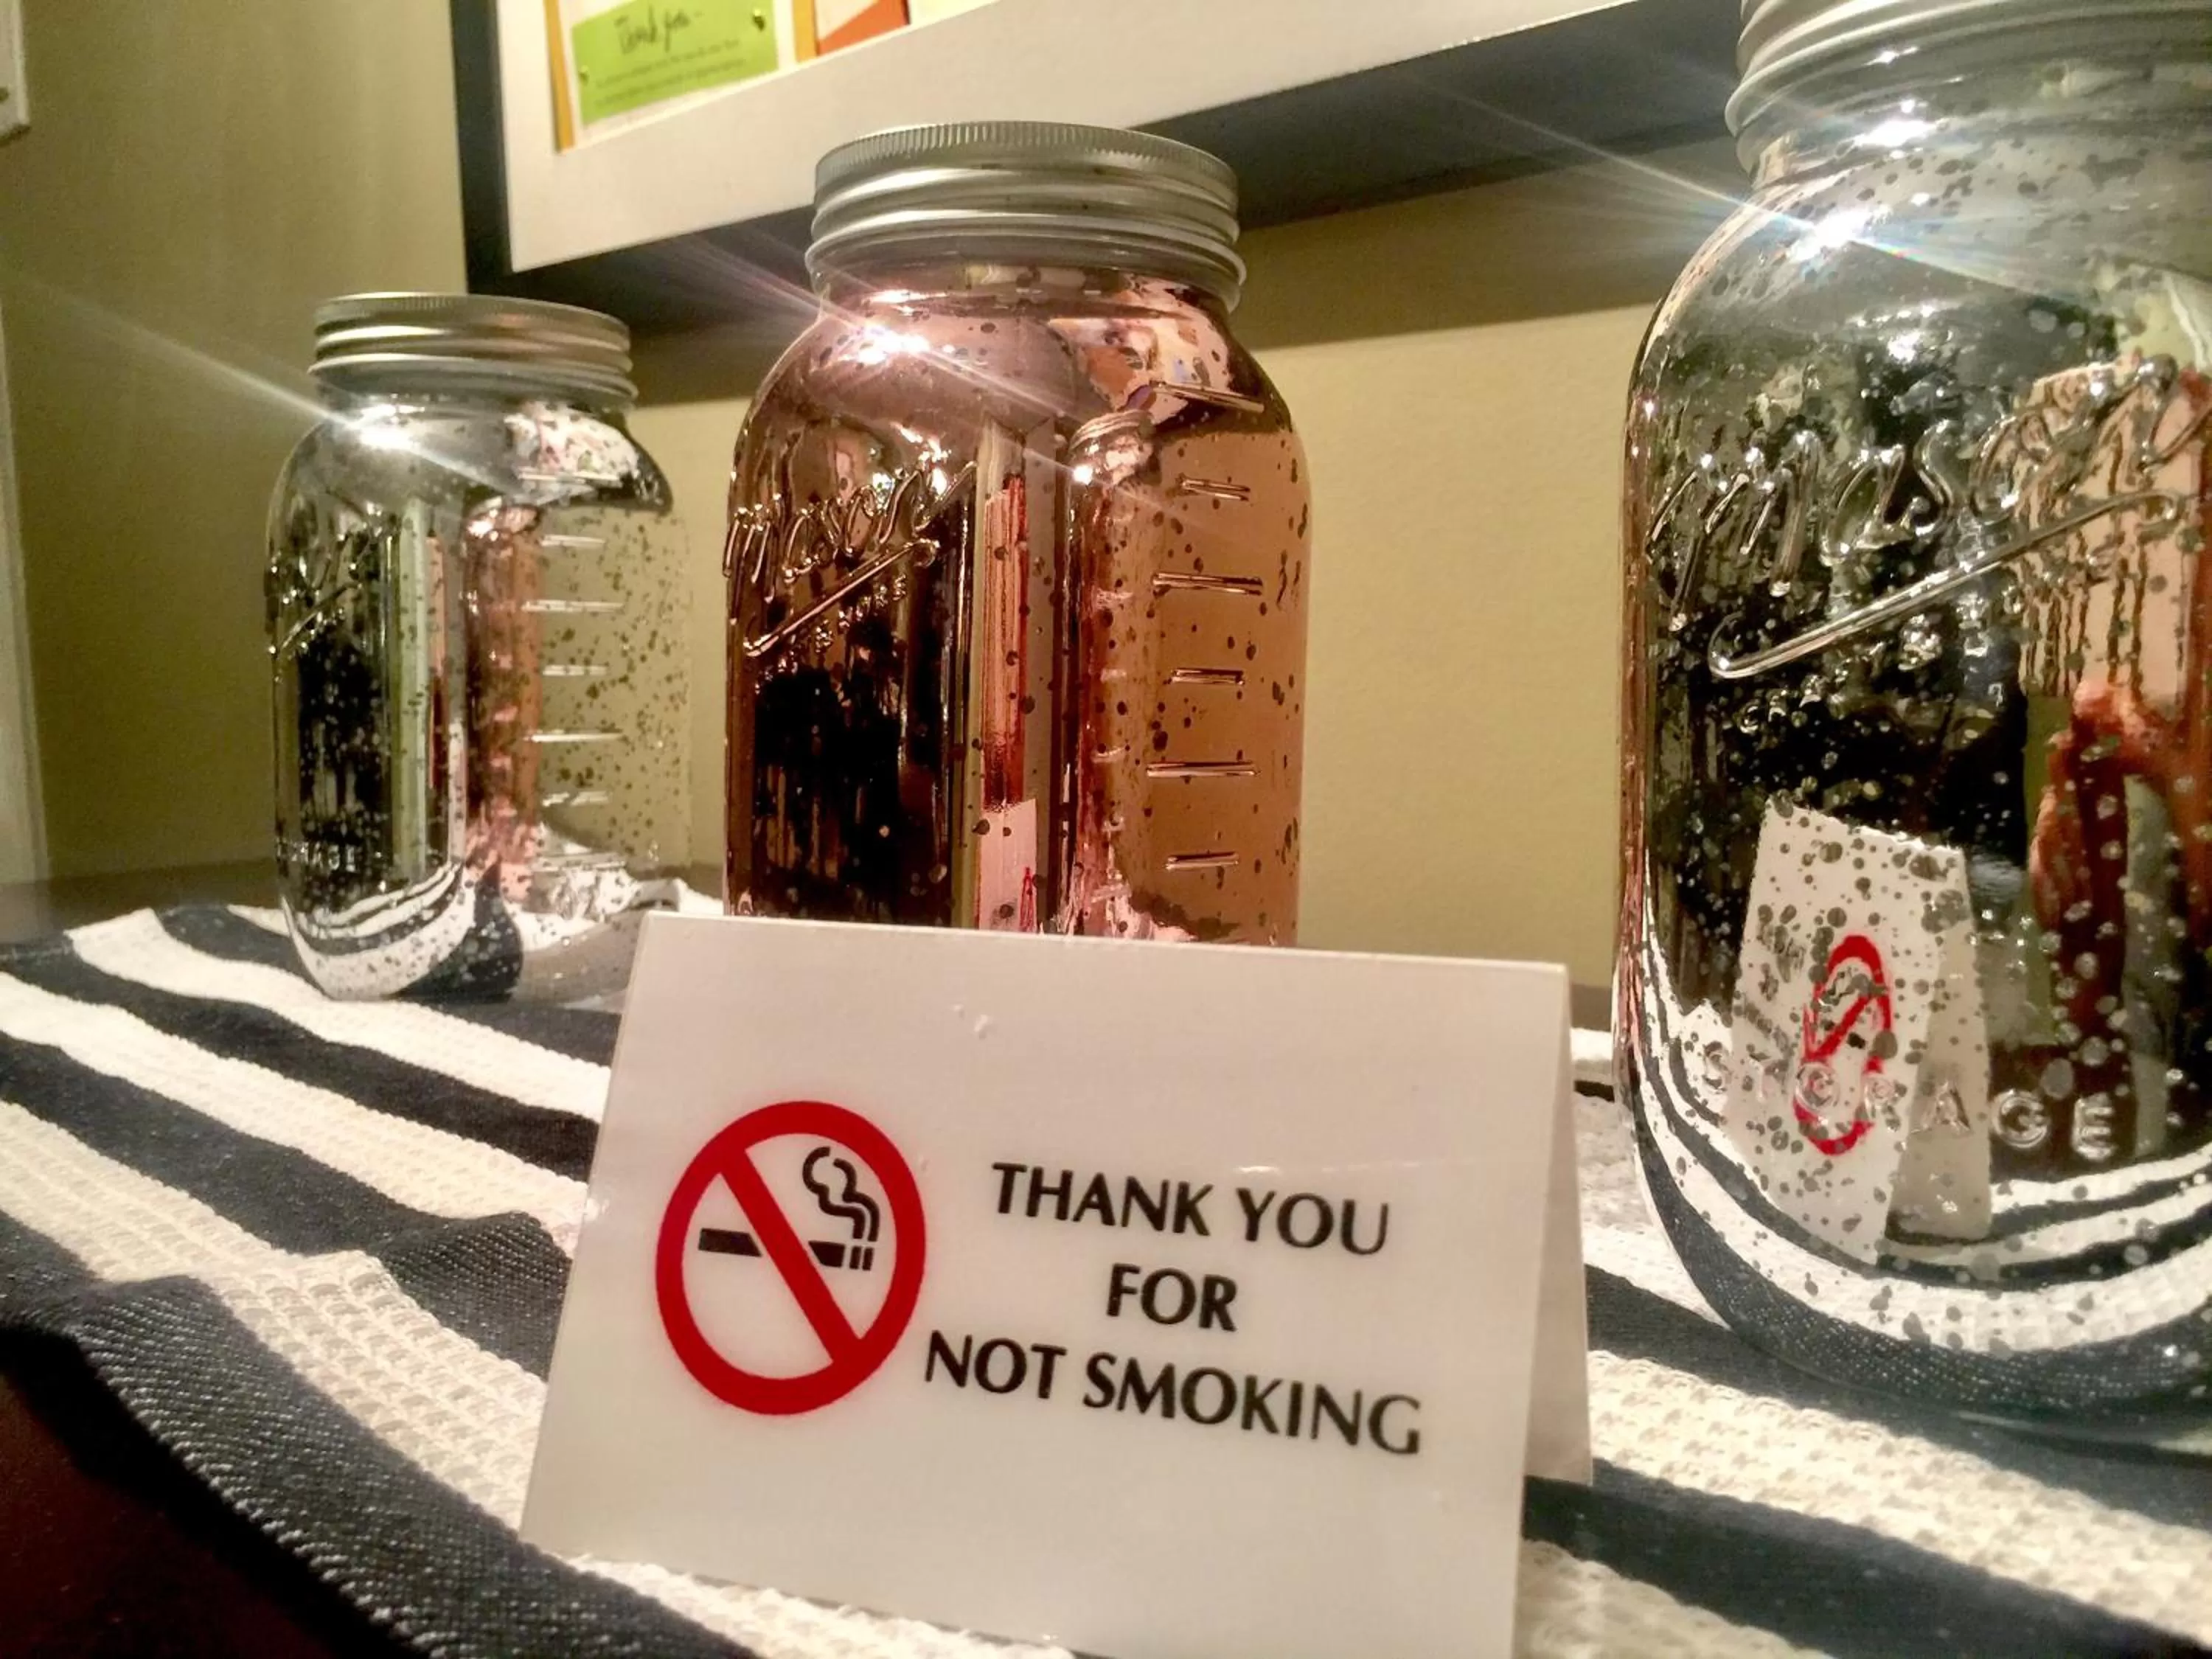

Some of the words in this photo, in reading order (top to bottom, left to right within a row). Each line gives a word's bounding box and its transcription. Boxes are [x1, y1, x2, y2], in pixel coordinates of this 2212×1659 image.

[992, 1161, 1214, 1237] THANK
[1235, 1187, 1391, 1256] YOU
[1106, 1263, 1238, 1332] FOR
[925, 1329, 1067, 1399] NOT
[1082, 1352, 1422, 1455] SMOKING
